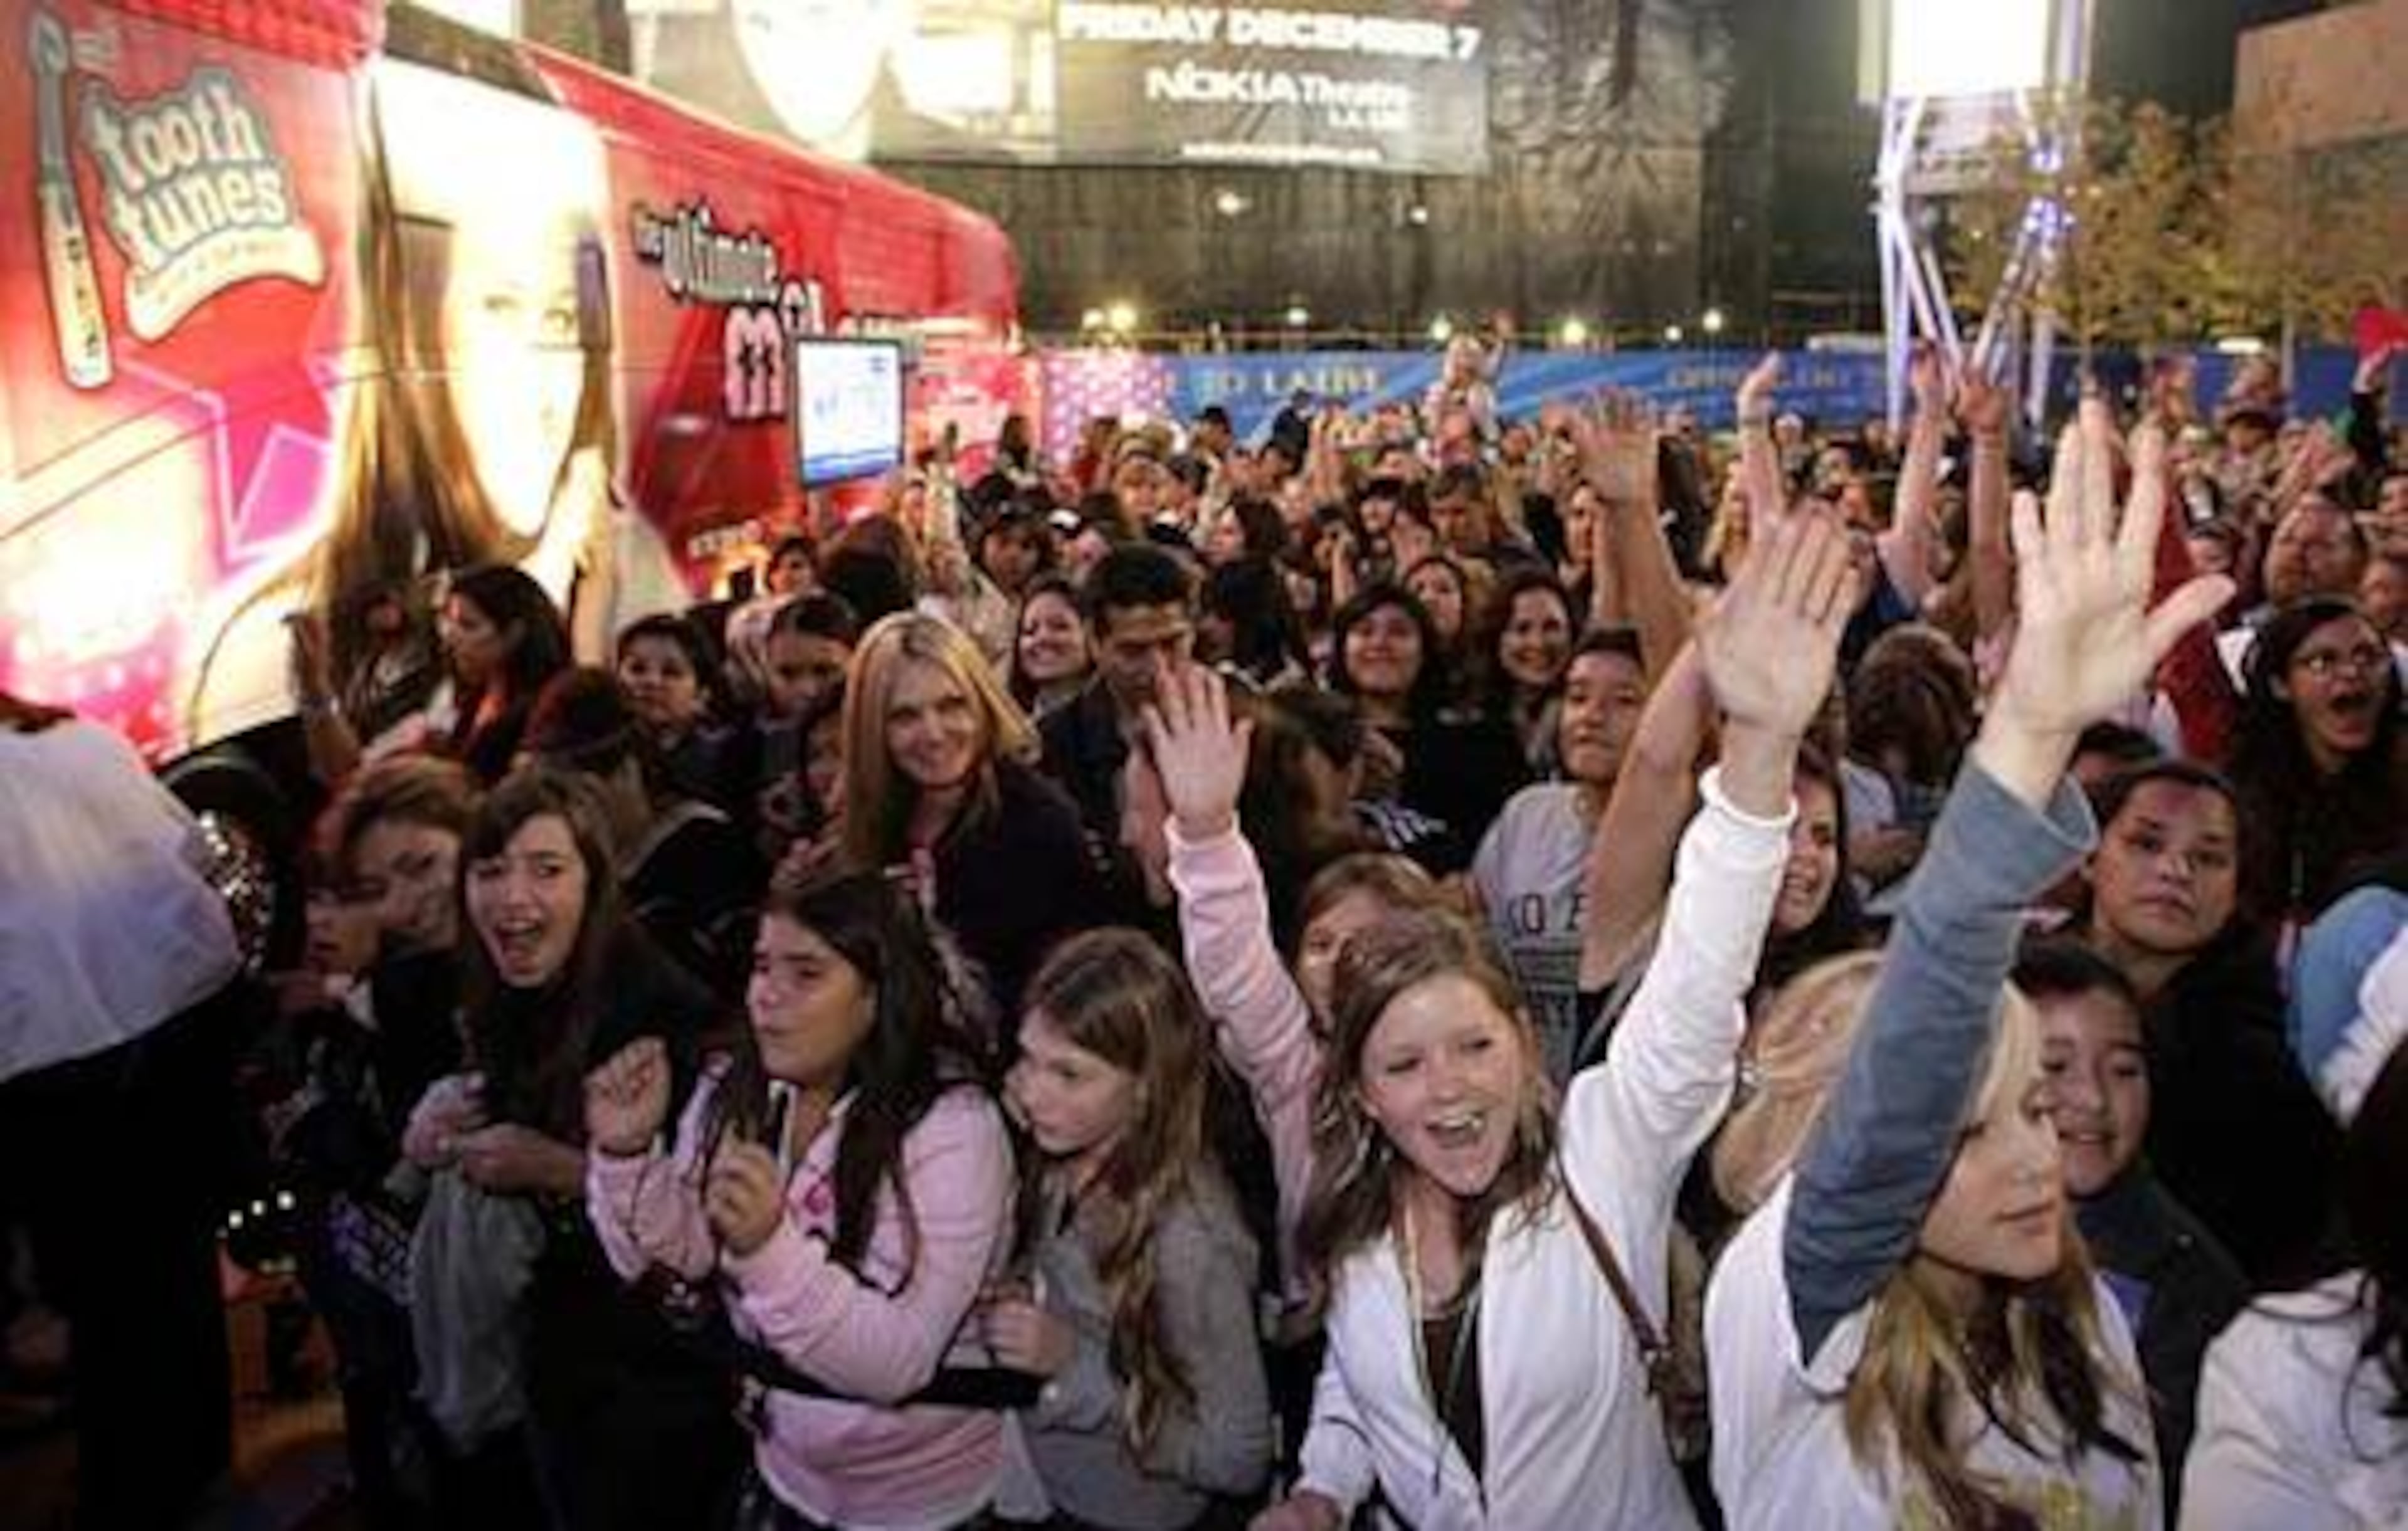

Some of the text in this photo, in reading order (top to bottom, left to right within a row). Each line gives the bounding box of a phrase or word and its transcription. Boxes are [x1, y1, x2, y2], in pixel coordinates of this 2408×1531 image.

[1059, 5, 1480, 59] FRIDAY DECEMBER 7
[1145, 68, 1297, 102] NOKIA
[91, 78, 267, 189] tooth
[110, 163, 286, 271] tunes
